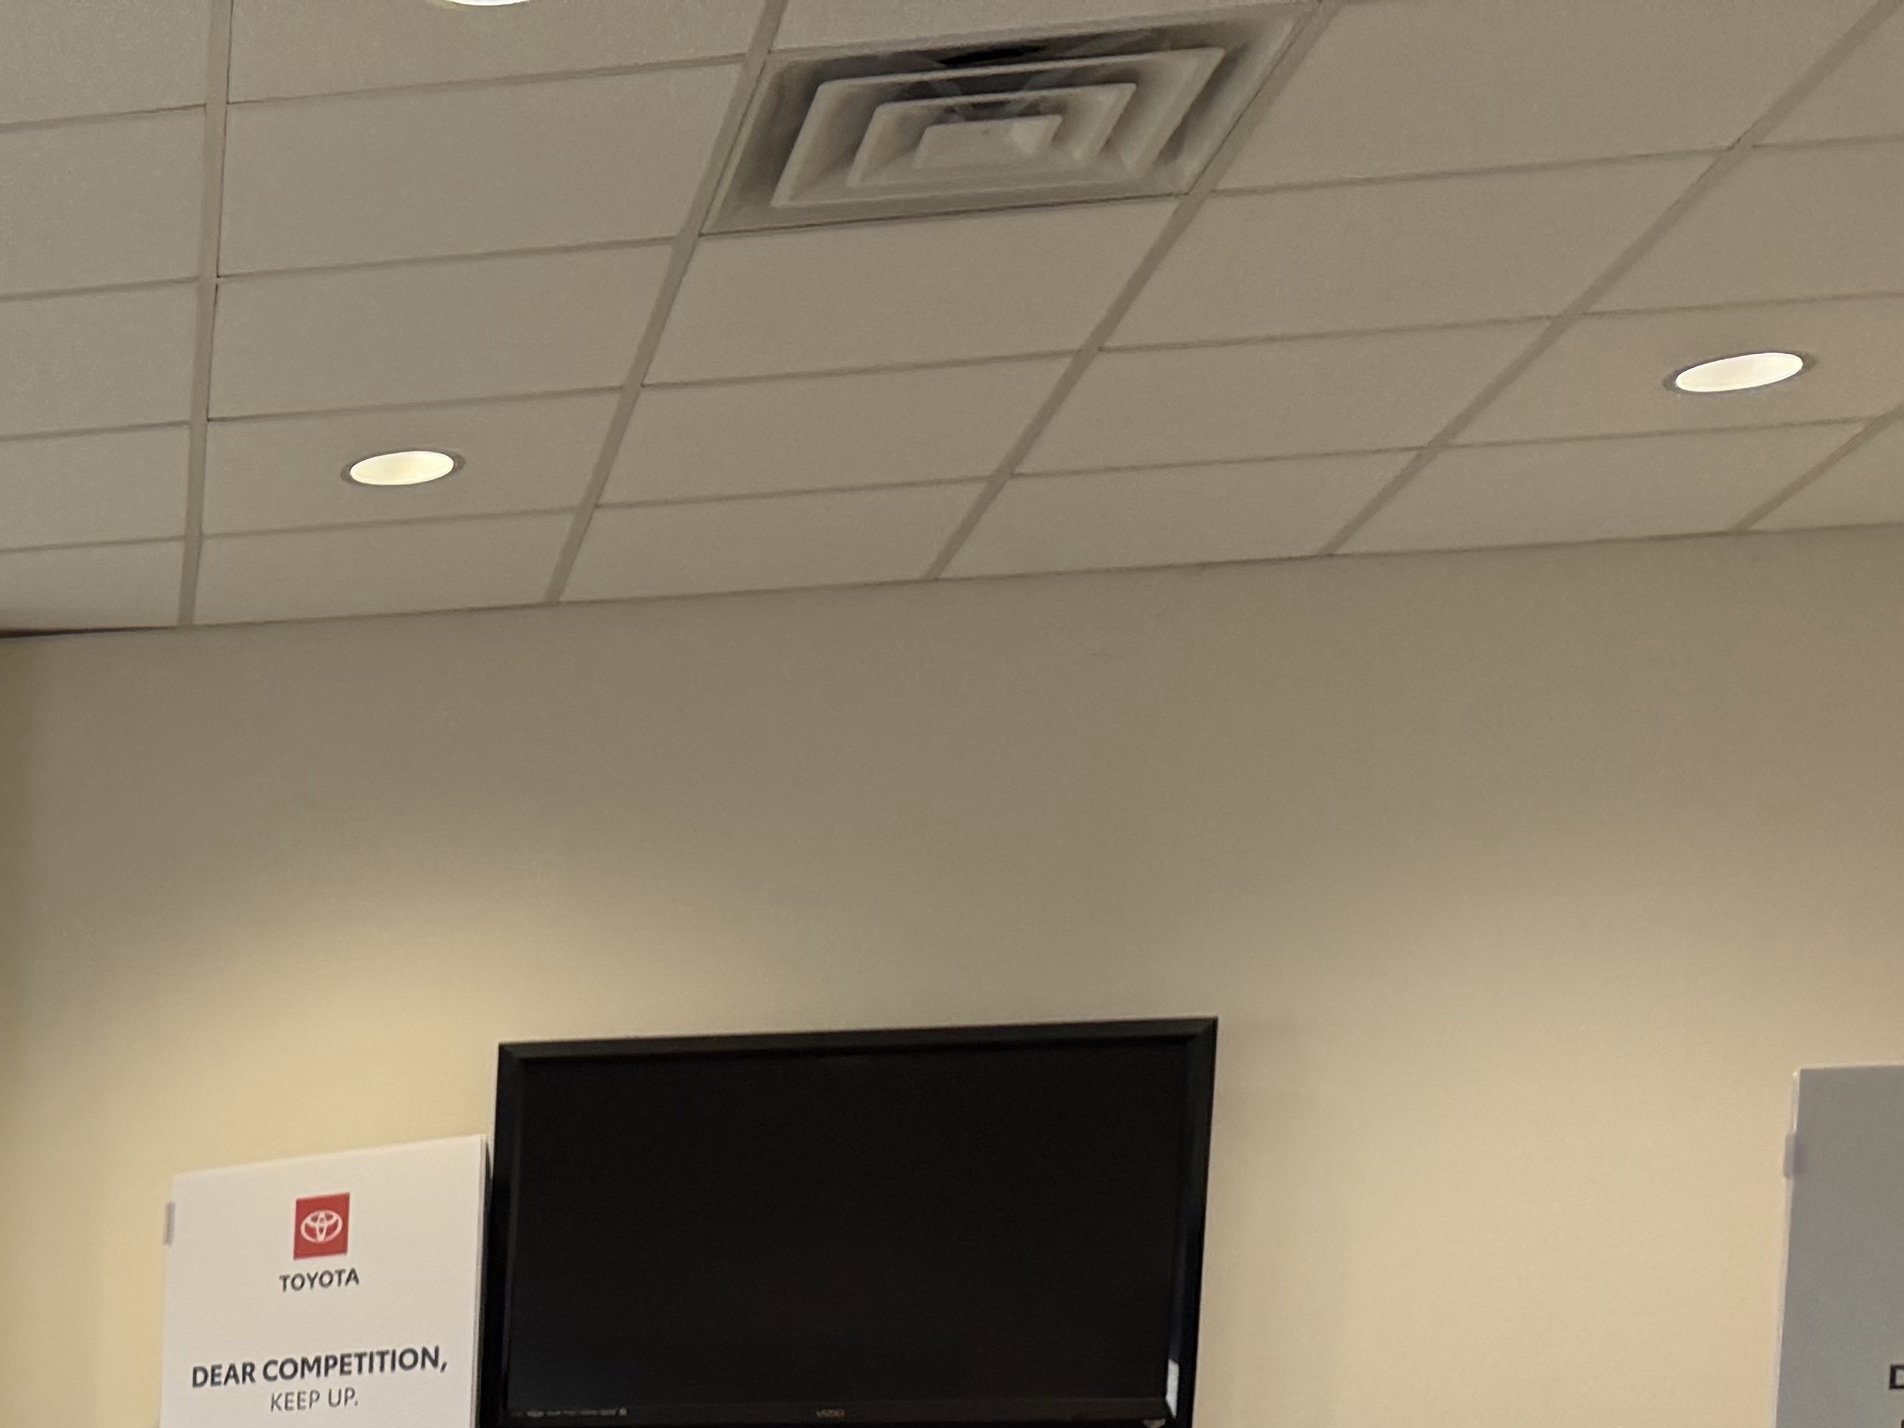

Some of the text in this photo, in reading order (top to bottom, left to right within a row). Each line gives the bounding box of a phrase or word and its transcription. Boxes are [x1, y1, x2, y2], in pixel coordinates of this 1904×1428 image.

[279, 1268, 360, 1293] TOYOTA
[191, 1345, 447, 1388] DEAR COMPETITION,
[270, 1386, 359, 1412] KEEP UP.
